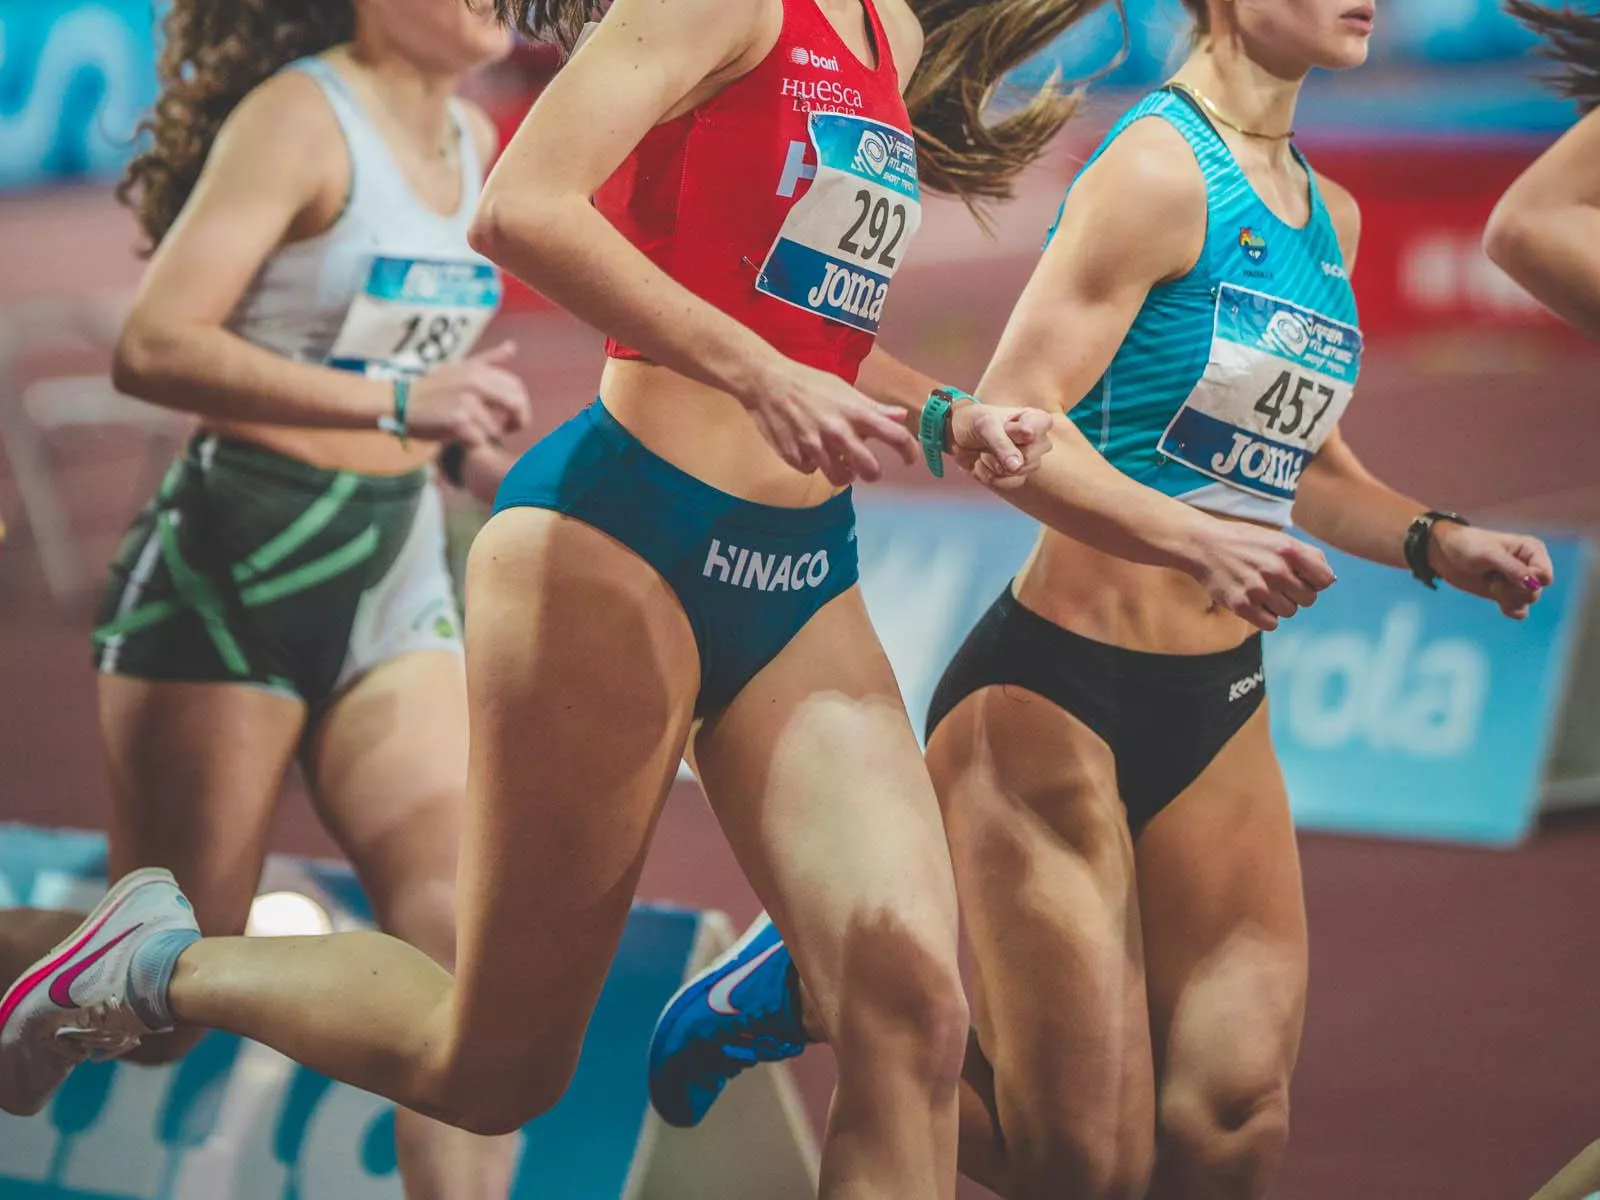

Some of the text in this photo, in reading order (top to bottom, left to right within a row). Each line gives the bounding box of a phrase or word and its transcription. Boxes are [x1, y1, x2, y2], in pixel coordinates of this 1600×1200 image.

[837, 190, 906, 269] 292
[1253, 370, 1335, 441] 457
[703, 538, 830, 592] HINACO
